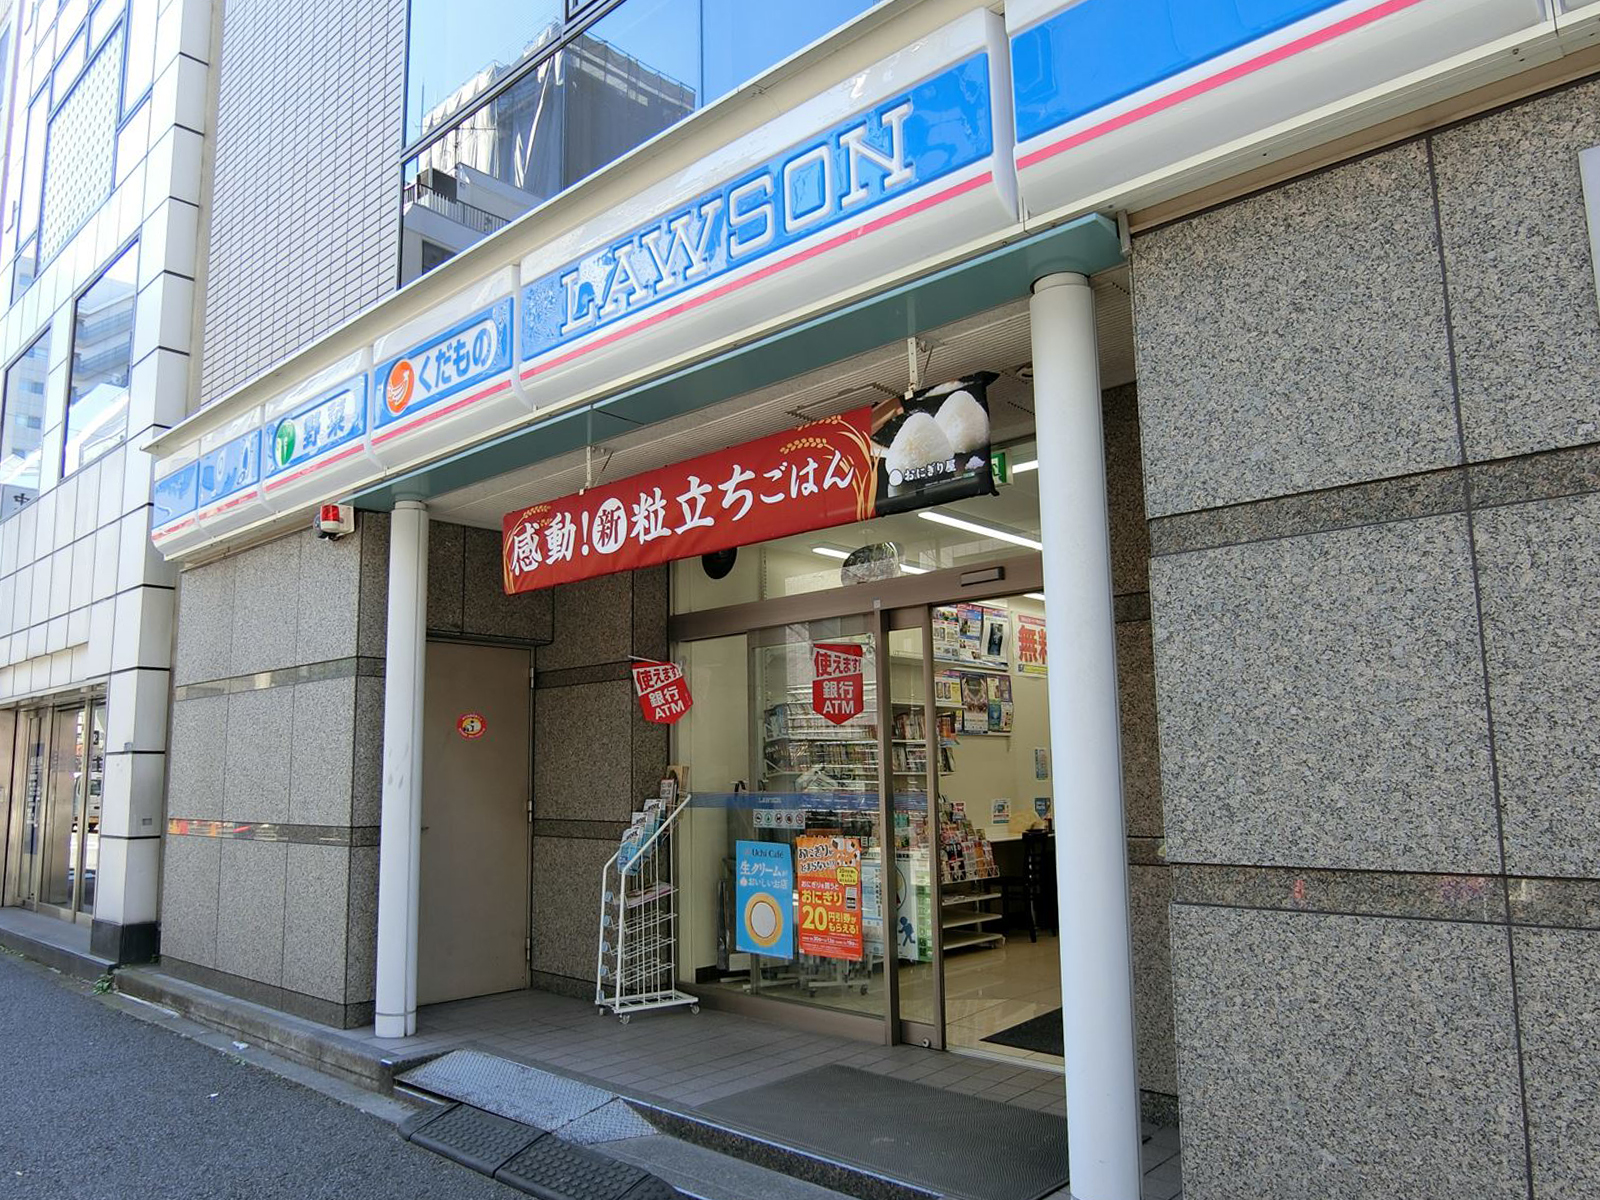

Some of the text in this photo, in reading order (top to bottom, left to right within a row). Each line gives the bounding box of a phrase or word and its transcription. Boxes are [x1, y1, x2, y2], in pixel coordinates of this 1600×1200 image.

[561, 103, 914, 335] LAWSON
[418, 328, 491, 393] くだもの
[303, 397, 347, 450] 野菜
[904, 458, 957, 481] おにぎり屋
[648, 685, 679, 707] 銀行
[823, 681, 853, 699] 銀行
[655, 700, 685, 720] ATM
[823, 700, 854, 714] ATM
[752, 848, 784, 858] Uchi Café
[801, 889, 842, 907] おにぎり
[802, 905, 828, 931] 20
